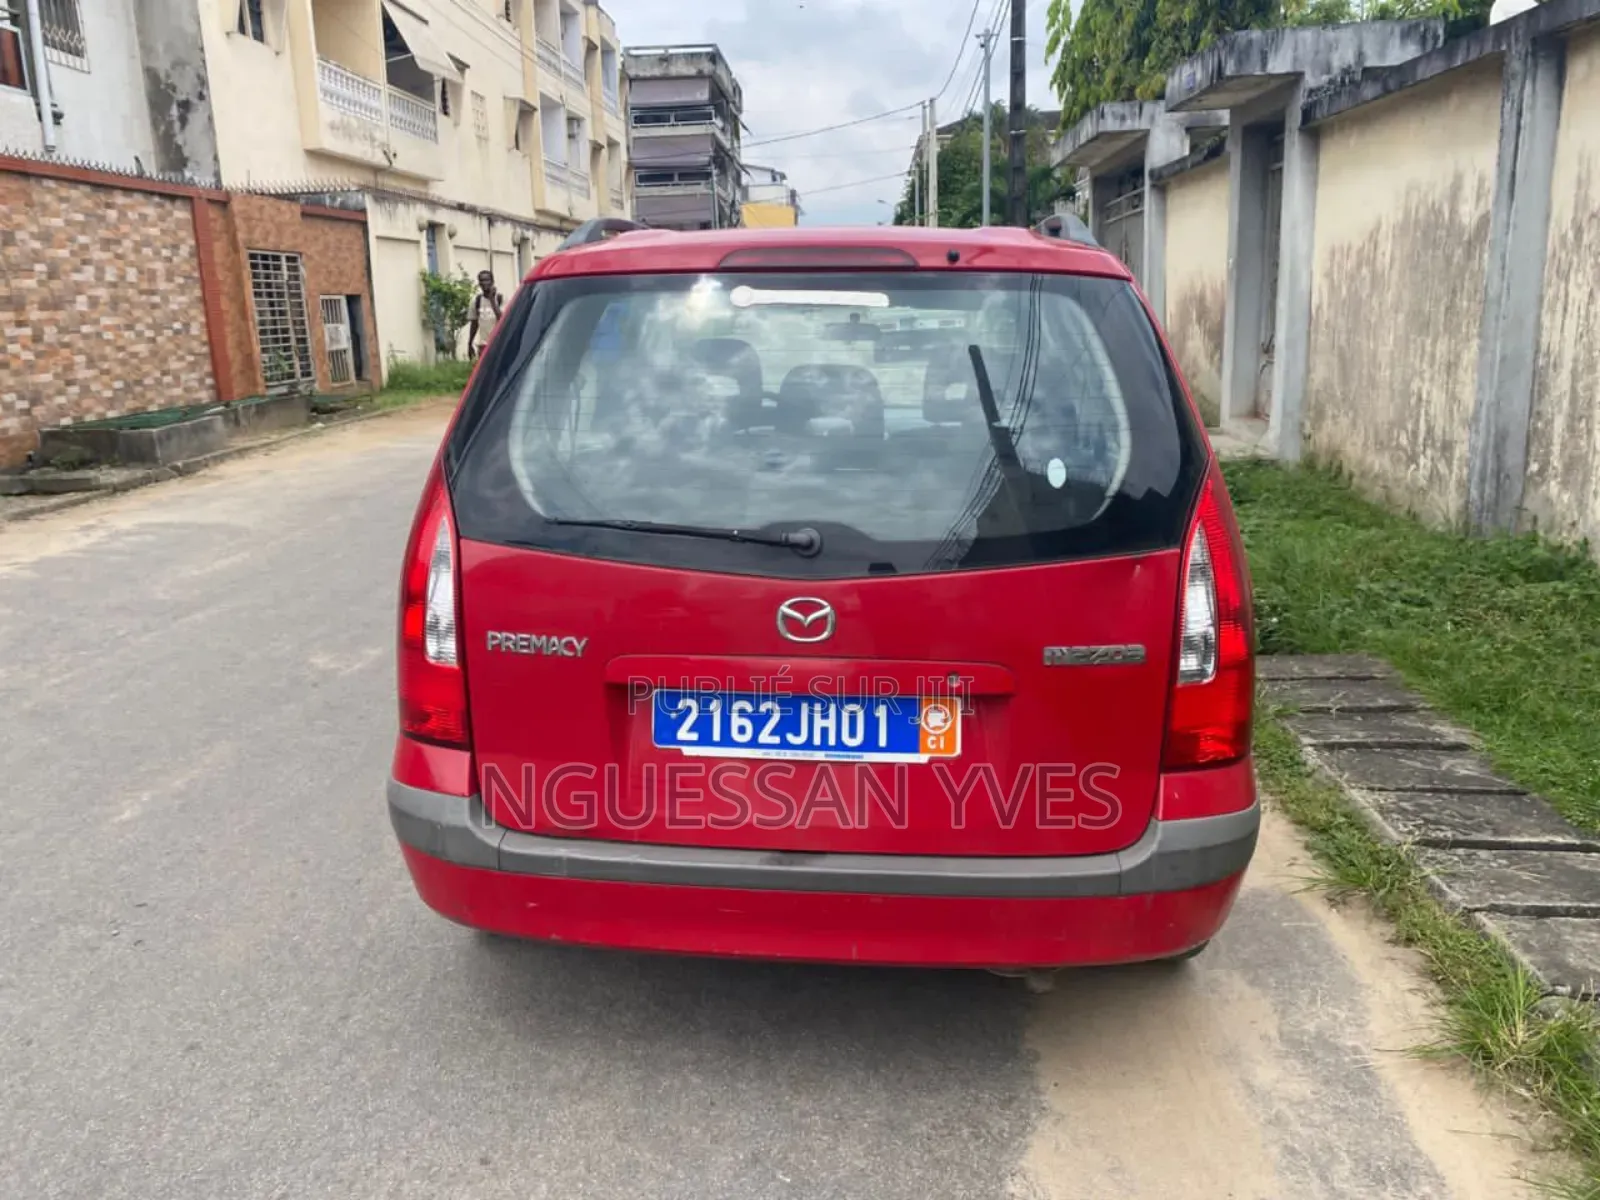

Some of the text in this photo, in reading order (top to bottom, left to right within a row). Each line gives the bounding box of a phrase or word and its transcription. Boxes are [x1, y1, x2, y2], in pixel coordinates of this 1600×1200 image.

[486, 630, 589, 657] PREMACY
[676, 698, 888, 748] 2162JH01
[927, 734, 946, 750] CI
